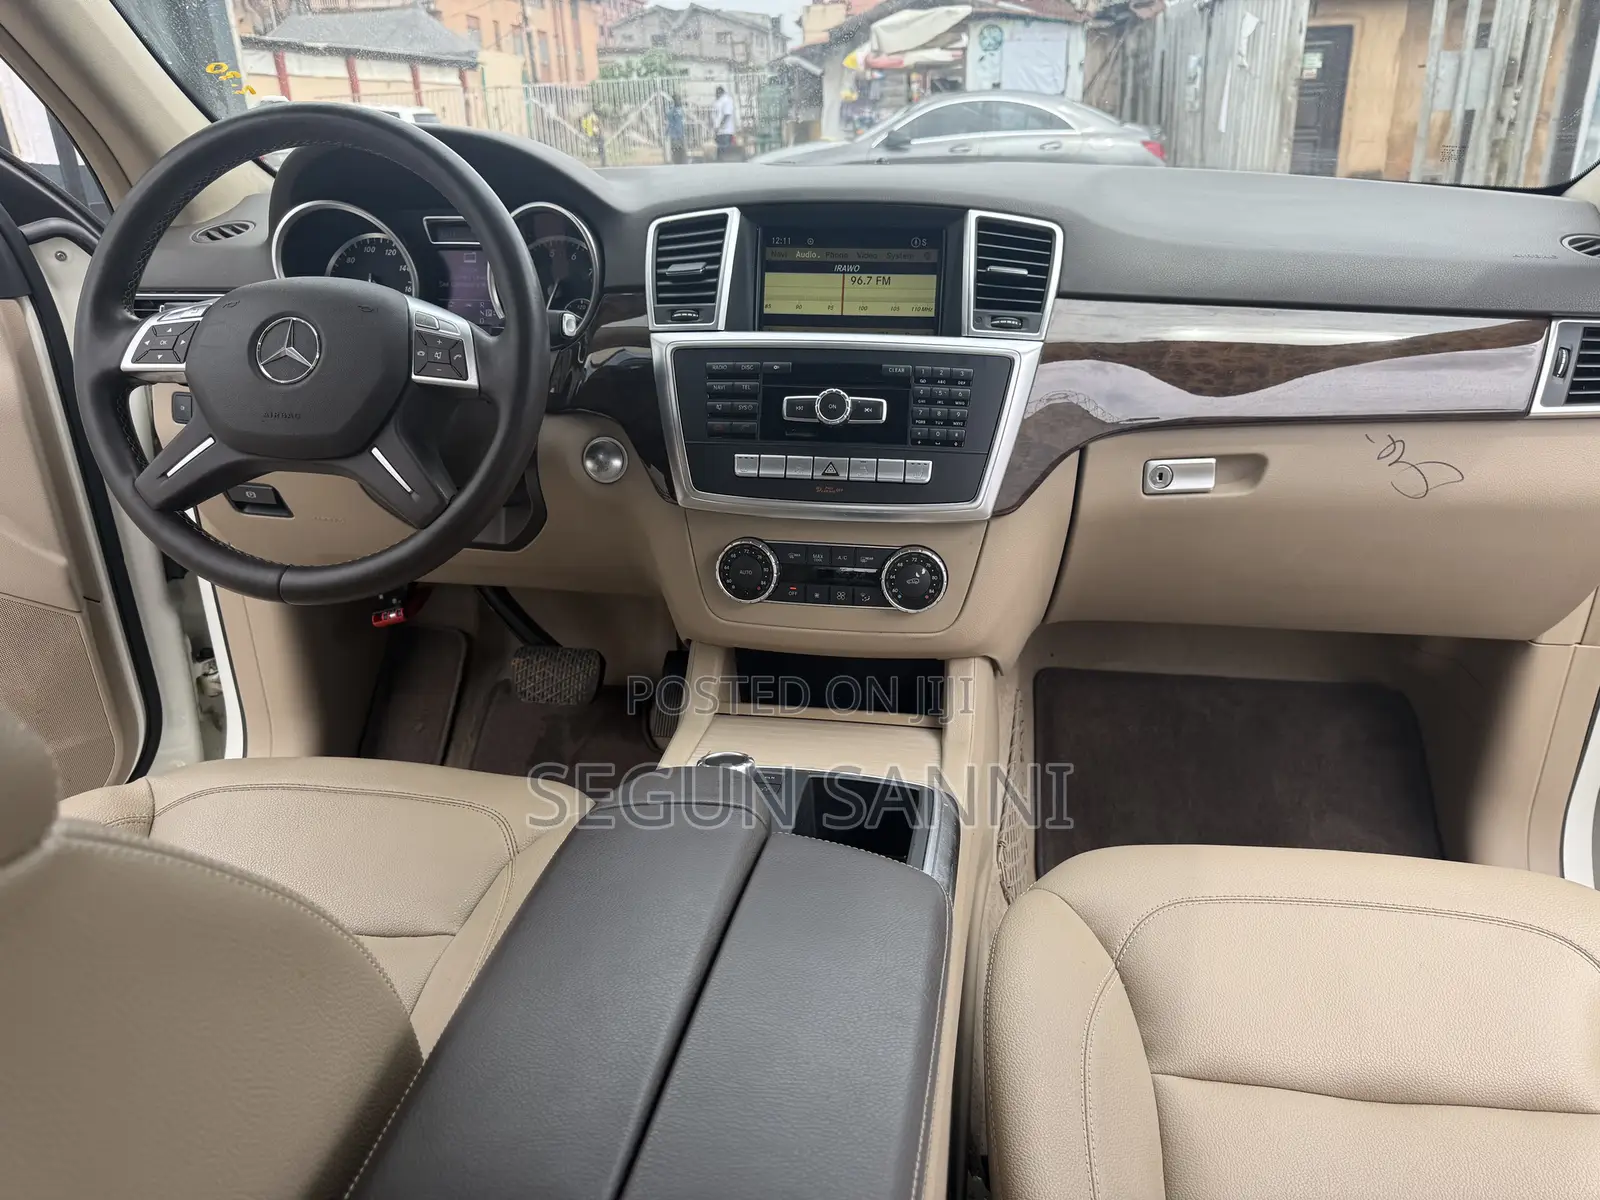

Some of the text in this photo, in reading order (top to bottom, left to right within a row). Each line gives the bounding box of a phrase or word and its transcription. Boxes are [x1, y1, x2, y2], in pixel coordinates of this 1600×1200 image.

[771, 236, 792, 245] 12:11
[384, 248, 397, 256] 120
[570, 252, 577, 261] 6
[825, 251, 849, 260] Phone
[856, 251, 878, 260] Video
[885, 251, 915, 261] System
[345, 256, 356, 265] 80
[833, 264, 861, 273] IRAWO
[850, 275, 892, 286] 96.7 FM
